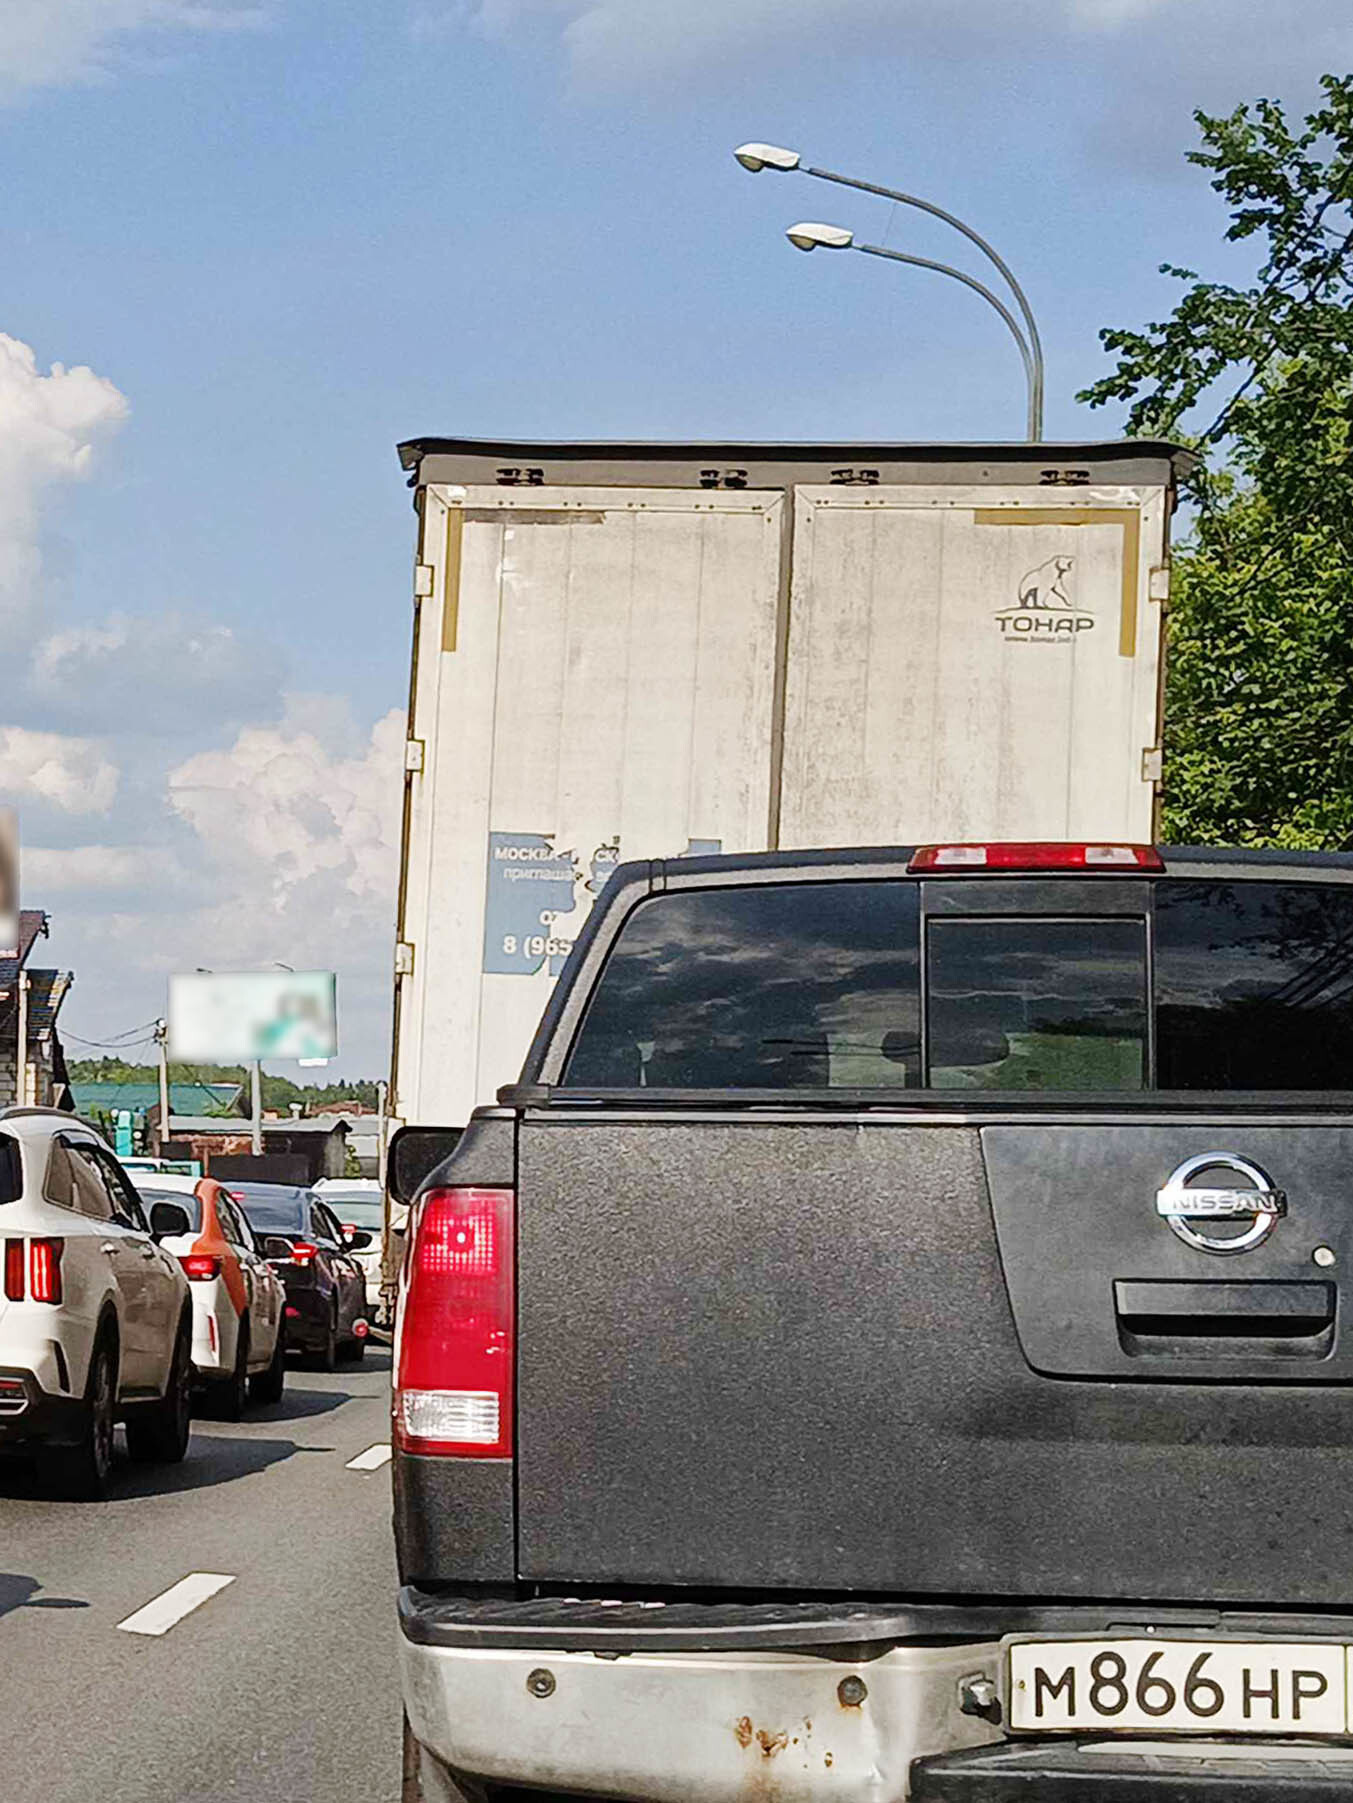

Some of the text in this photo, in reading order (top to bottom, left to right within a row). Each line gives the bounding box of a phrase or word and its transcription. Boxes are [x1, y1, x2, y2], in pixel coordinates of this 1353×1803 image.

[995, 616, 1094, 632] ТОНАР
[504, 936, 517, 954] 8
[1174, 1195, 1277, 1213] NISSAN
